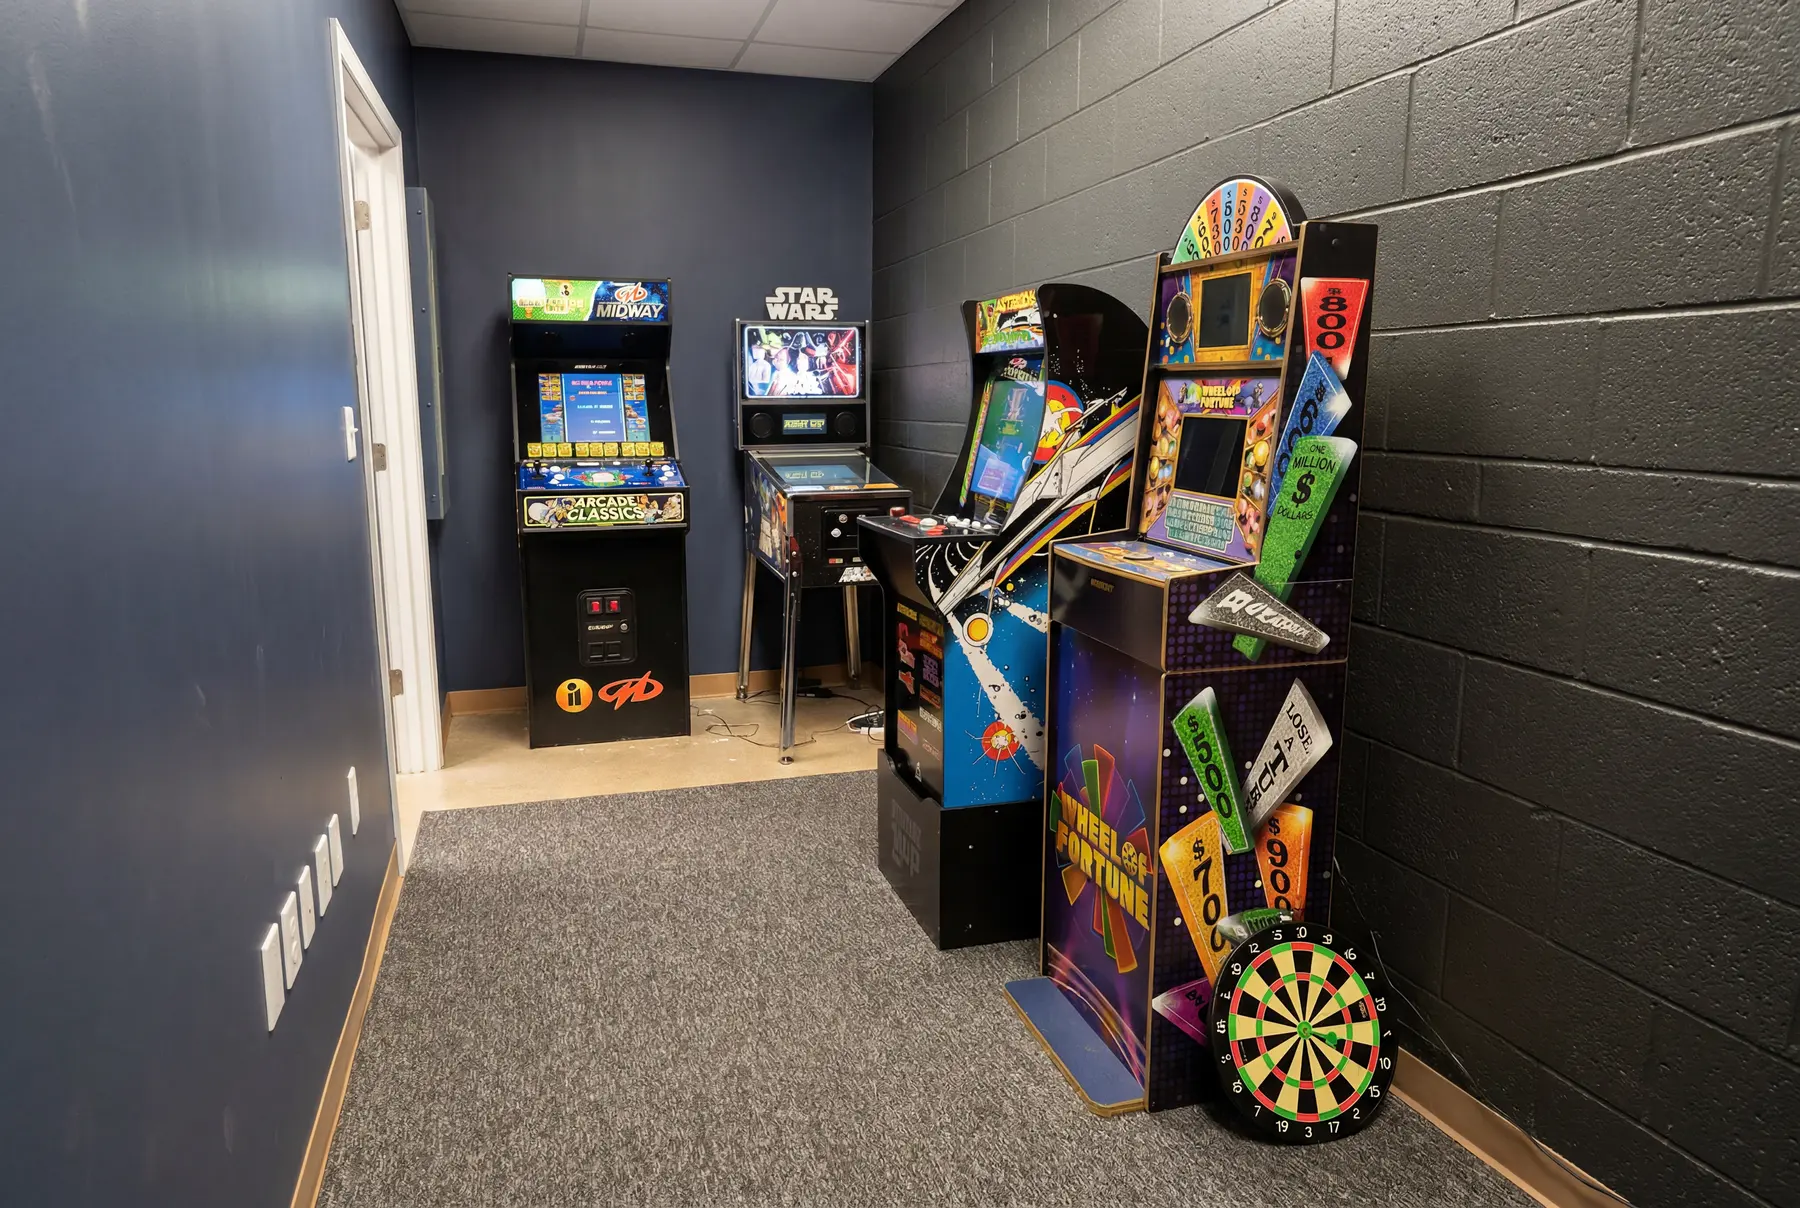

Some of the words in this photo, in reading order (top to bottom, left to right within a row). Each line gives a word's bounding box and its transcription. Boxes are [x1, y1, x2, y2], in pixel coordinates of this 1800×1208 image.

[766, 287, 838, 303] STAR
[596, 303, 664, 318] MIDWAY
[766, 303, 838, 320] WARS
[1310, 444, 1326, 454] ONE
[1292, 456, 1336, 473] MILLION
[574, 496, 638, 508] ARCADE
[567, 507, 645, 521] CLASSICS
[1277, 505, 1313, 520] DOLLARS
[1187, 714, 1232, 819] $500
[1061, 790, 1122, 866] WHEEL
[1121, 841, 1147, 885] OF
[1056, 819, 1150, 931] FORTUNE
[1249, 943, 1260, 953] 12
[1380, 1057, 1391, 1069] 10
[1369, 1086, 1380, 1097] 15
[1254, 1105, 1262, 1117] 7
[1353, 1108, 1360, 1120] 2
[1276, 1121, 1288, 1133] 19
[1305, 1126, 1313, 1138] 3
[1328, 1122, 1341, 1133] 17
